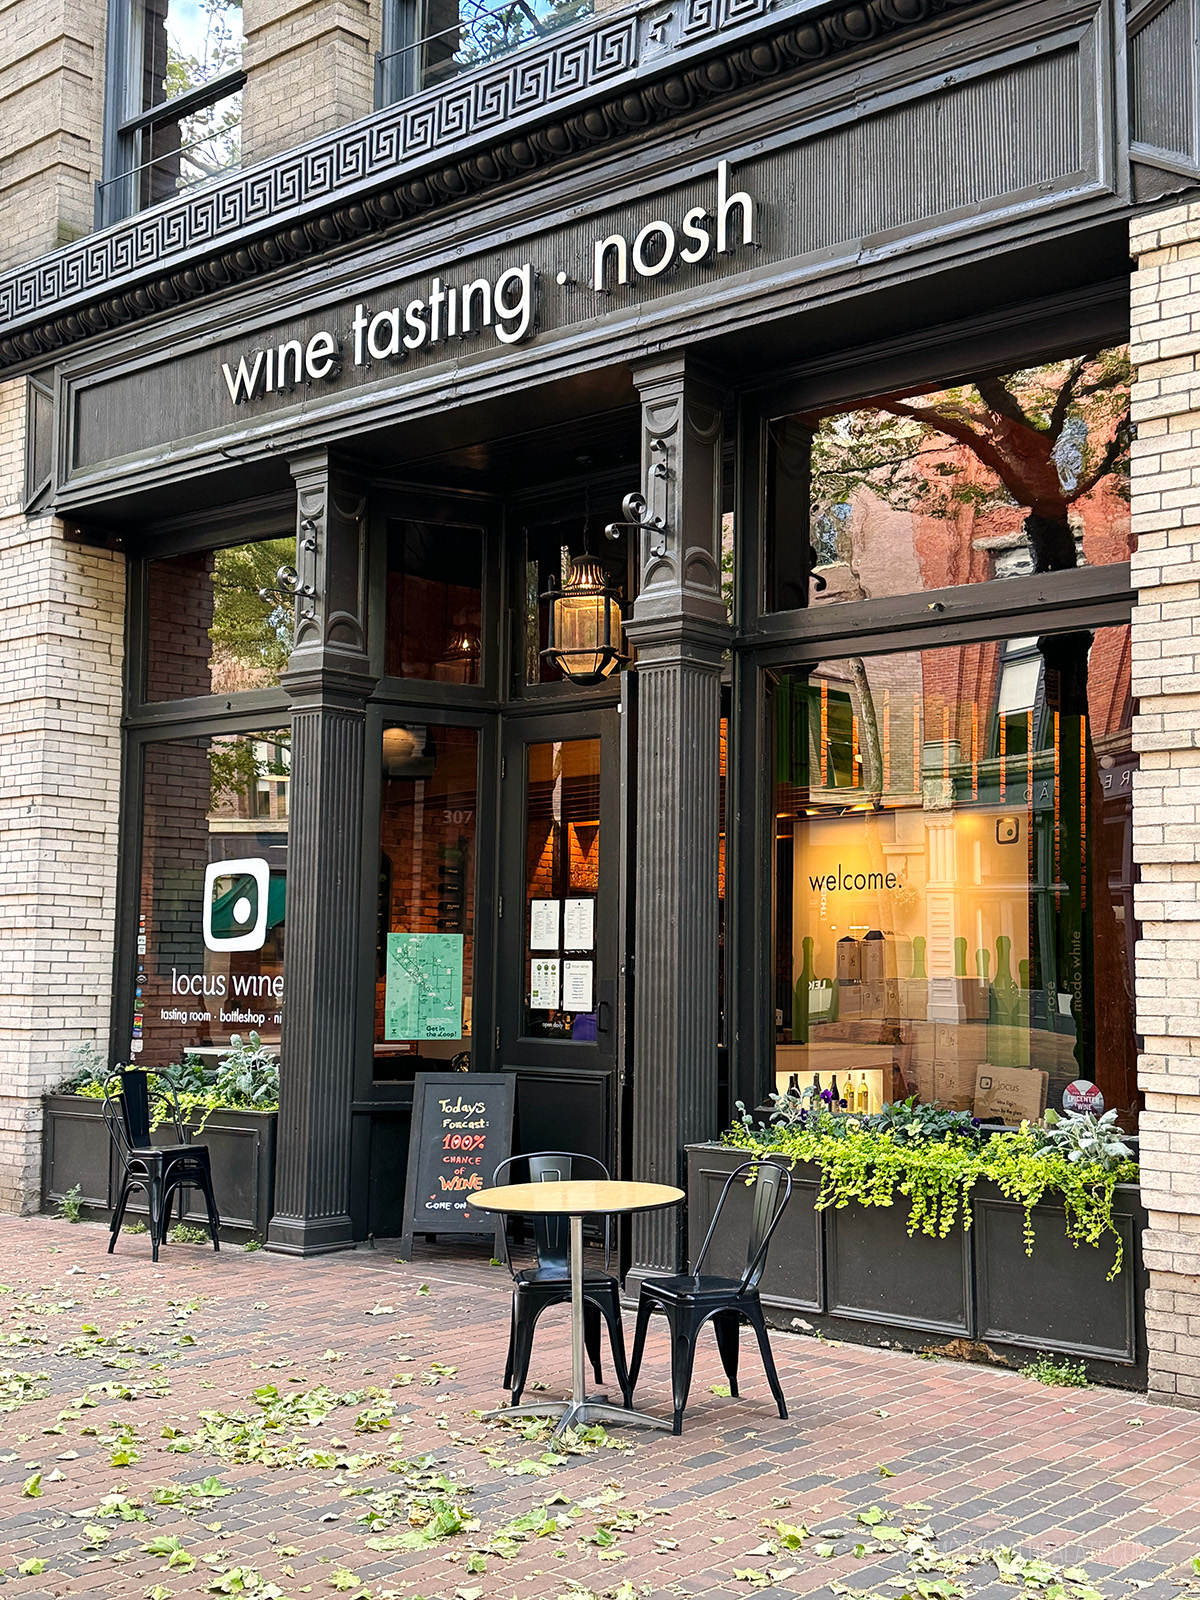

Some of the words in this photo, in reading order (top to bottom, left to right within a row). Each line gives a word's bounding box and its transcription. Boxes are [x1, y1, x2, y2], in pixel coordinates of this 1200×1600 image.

[222, 329, 335, 404] wine
[352, 263, 533, 343] tasting
[594, 159, 755, 292] nosh
[442, 810, 473, 824] 307
[808, 863, 902, 892] welcome.
[1068, 931, 1081, 968] white
[171, 967, 226, 996] locus
[1070, 972, 1082, 1012] modo
[160, 1008, 188, 1024] tasting
[189, 1011, 211, 1022] room
[219, 1008, 265, 1027] bottleshop
[997, 1080, 1020, 1092] locus
[442, 1133, 486, 1151] 100%
[443, 1156, 482, 1165] CHANCE
[454, 1166, 466, 1175] of
[438, 1172, 483, 1191] WINE
[425, 1201, 451, 1210] COME
[453, 1201, 467, 1210] ON
